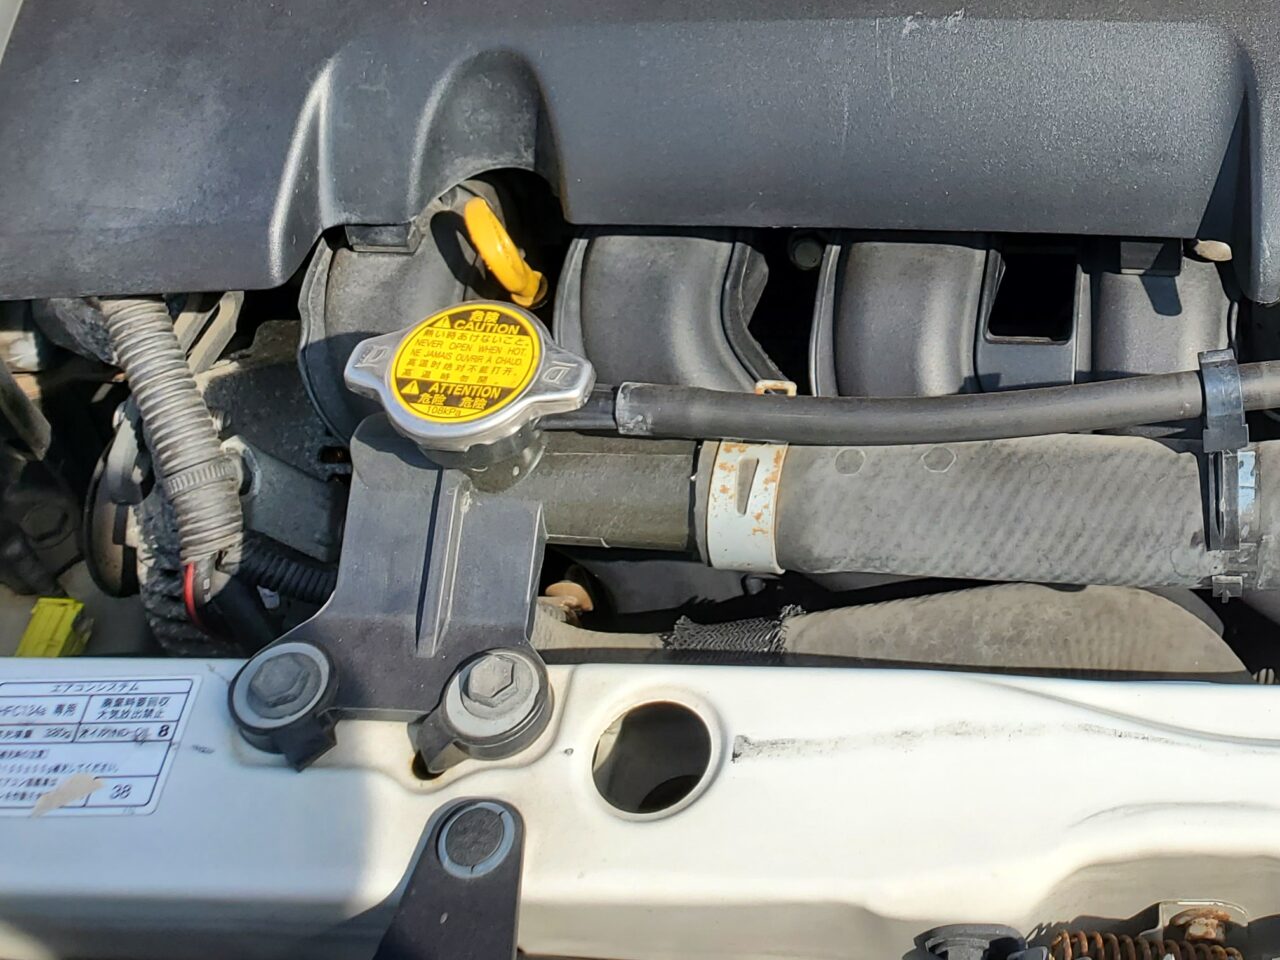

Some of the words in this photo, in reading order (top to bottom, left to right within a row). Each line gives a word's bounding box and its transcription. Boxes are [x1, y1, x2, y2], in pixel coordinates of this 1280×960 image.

[453, 320, 521, 335] CAUTION
[411, 348, 422, 357] NE
[424, 350, 453, 360] JAMAIS
[413, 339, 444, 349] NEVER
[448, 342, 473, 352] OPEN
[477, 344, 503, 354] WHEN
[428, 382, 502, 399] ATTENTION
[426, 405, 463, 417] 108kPa
